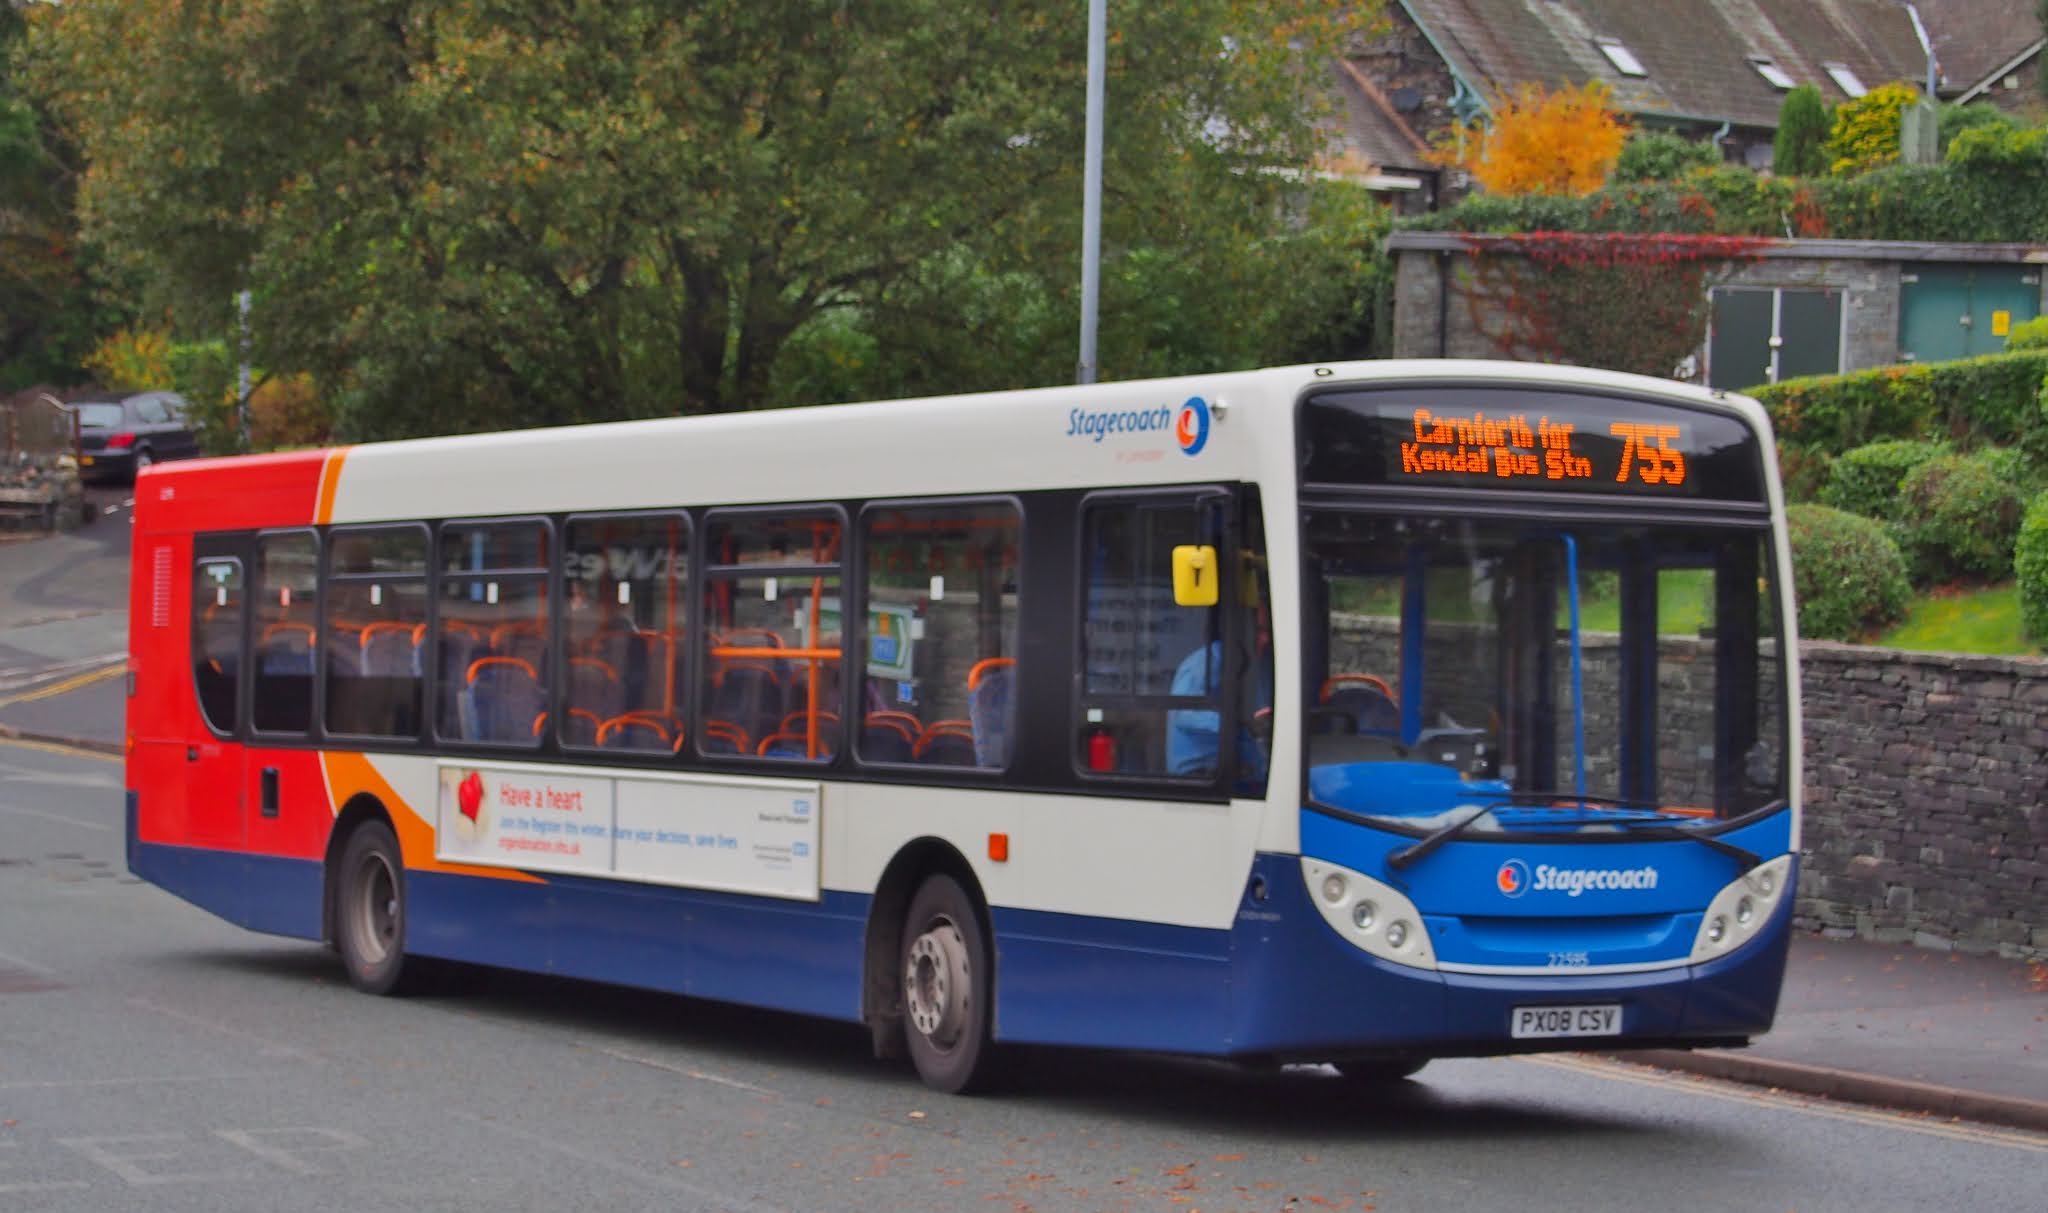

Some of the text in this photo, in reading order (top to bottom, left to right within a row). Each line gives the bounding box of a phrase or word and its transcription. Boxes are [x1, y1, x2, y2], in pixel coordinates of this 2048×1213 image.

[1067, 404, 1171, 443] Stagecoach
[1414, 409, 1575, 449] Carnforth for
[1401, 442, 1592, 479] Kendal Bus Stn
[1610, 422, 1686, 485] 755
[500, 783, 583, 813] Have a heart
[1533, 864, 1659, 898] Stagecoach
[1520, 1009, 1615, 1032] PX08 CSV
